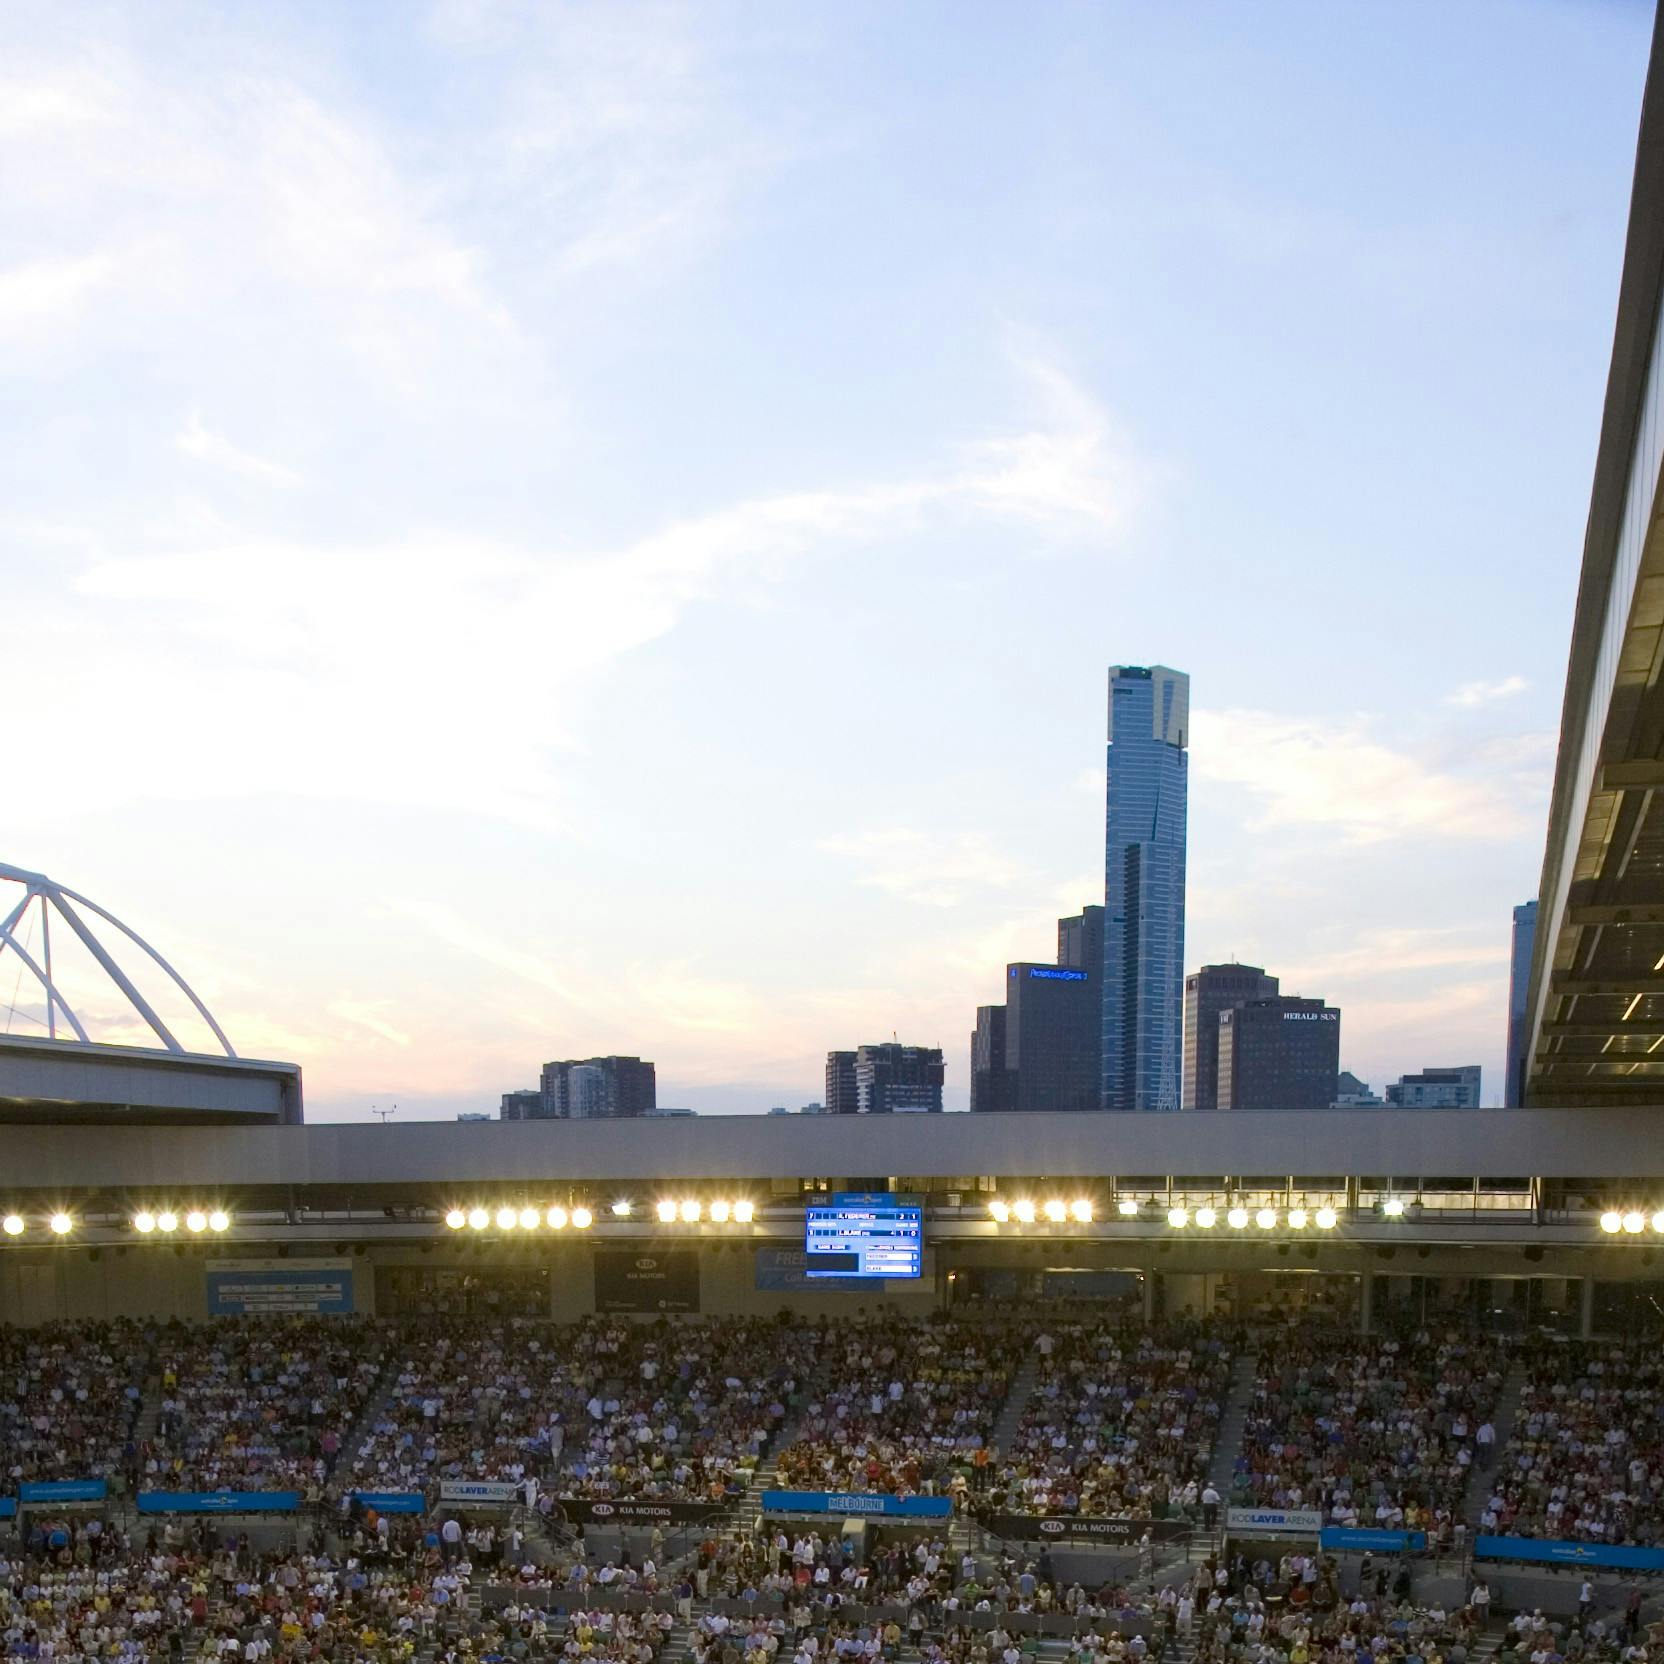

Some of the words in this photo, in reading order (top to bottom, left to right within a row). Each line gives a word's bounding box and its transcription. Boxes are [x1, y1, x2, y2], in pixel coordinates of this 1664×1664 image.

[1320, 1013, 1337, 1021] SUN
[828, 1498, 884, 1511] MELBOURNE
[620, 1507, 633, 1516] KIA
[636, 1508, 672, 1517] MOTORS
[1286, 1516, 1317, 1525] ARENA
[1072, 1524, 1090, 1533] KIA
[1093, 1525, 1130, 1534] MOTORS
